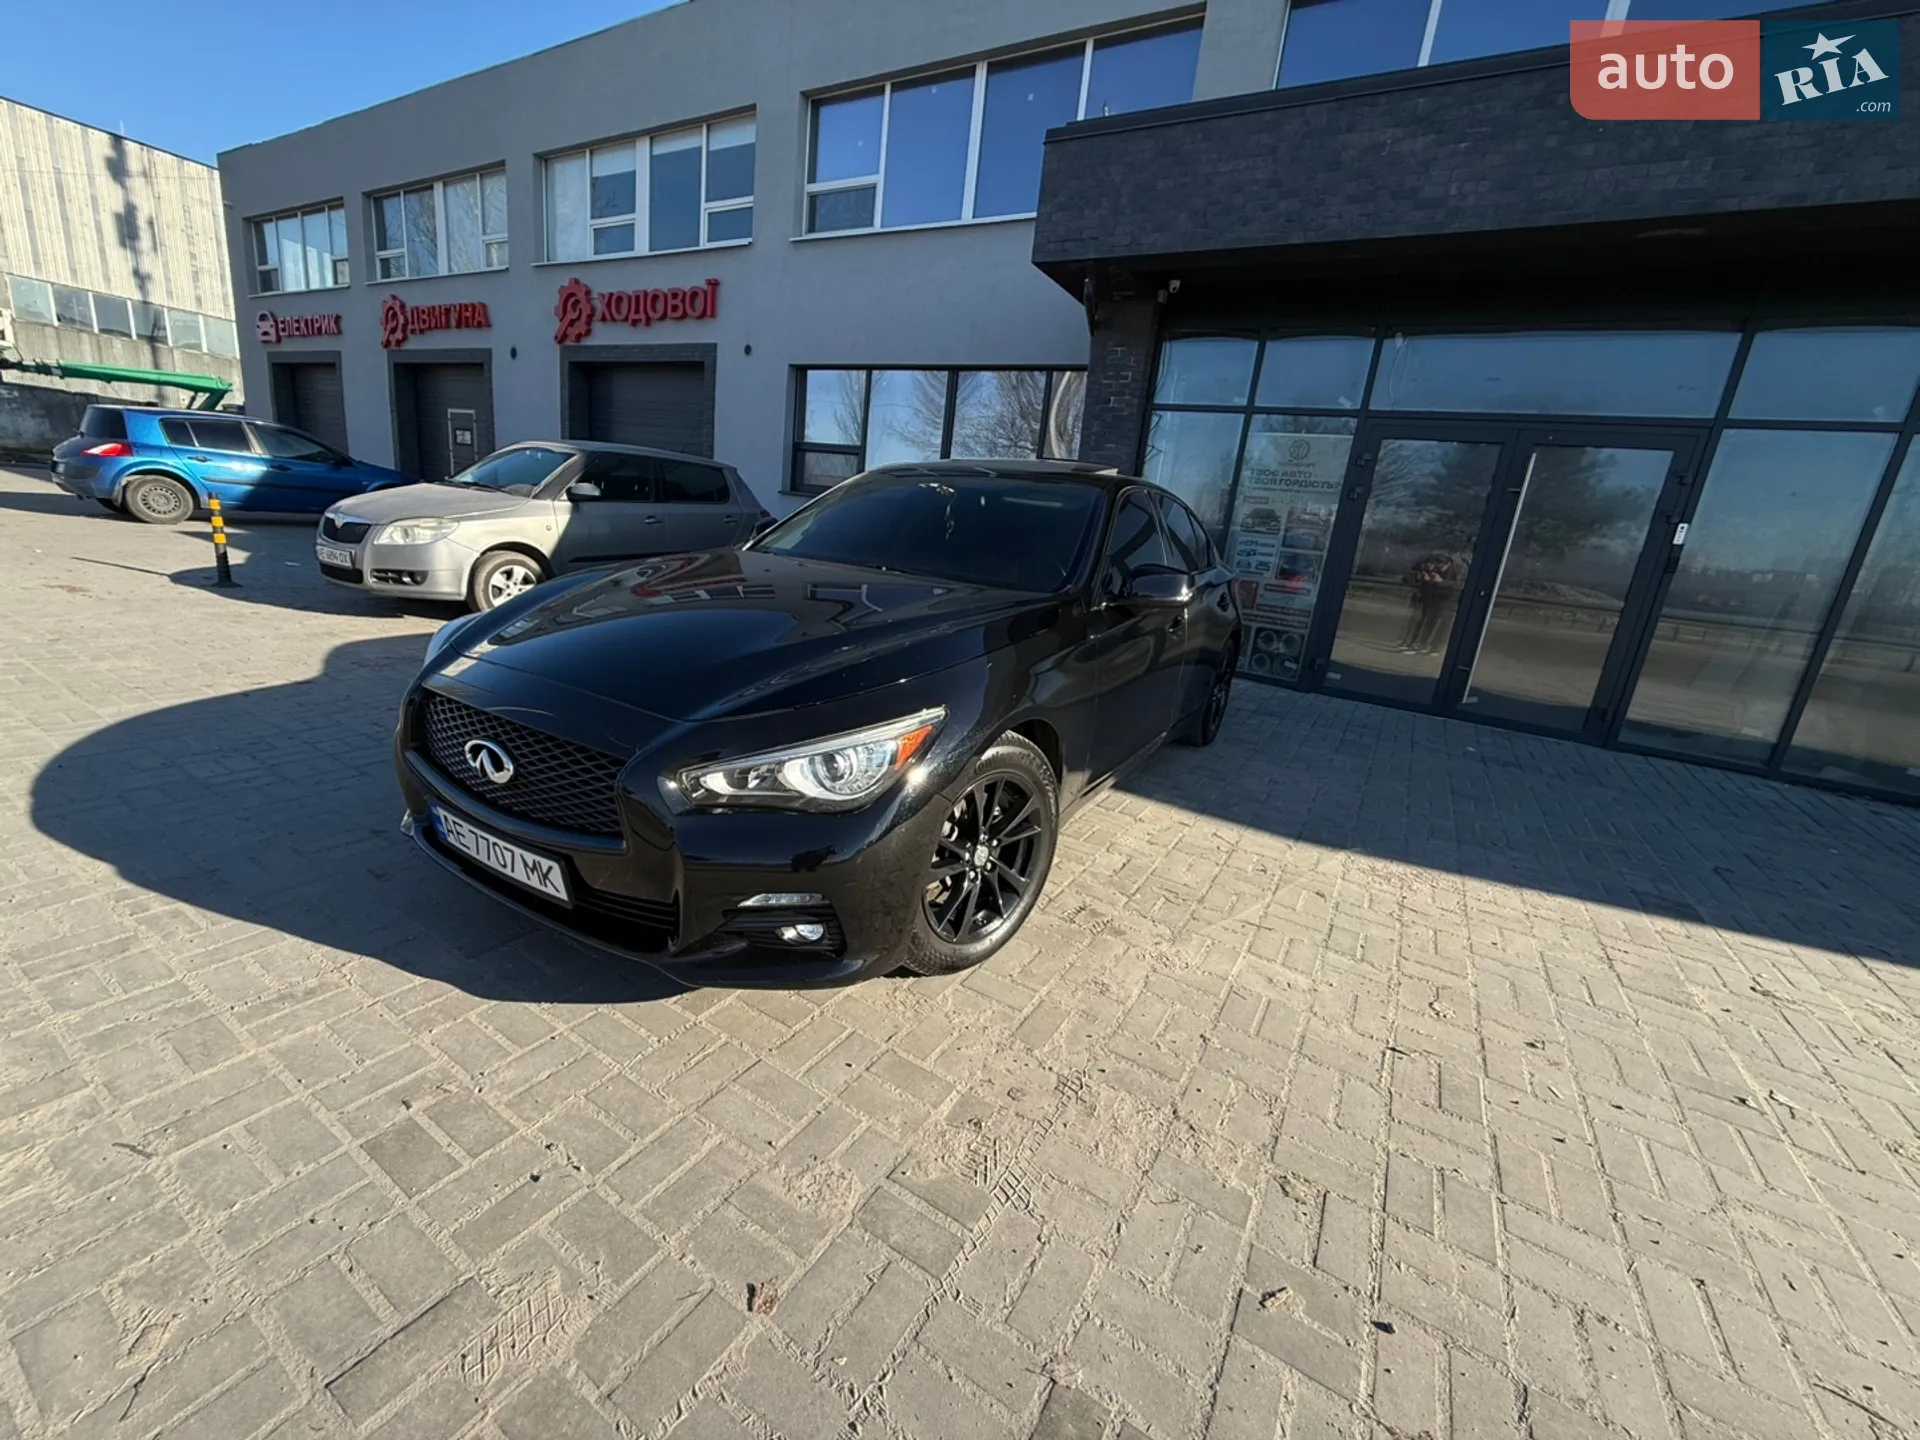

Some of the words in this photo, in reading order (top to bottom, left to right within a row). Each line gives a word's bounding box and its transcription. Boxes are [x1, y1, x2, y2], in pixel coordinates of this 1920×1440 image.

[408, 302, 492, 334] ДВИГУНА
[598, 277, 720, 327] ХОДОВОЇ
[278, 312, 342, 338] ЕЛЕКТРИК
[443, 814, 471, 851] AE
[468, 828, 516, 874] 7707
[520, 852, 561, 893] MK
